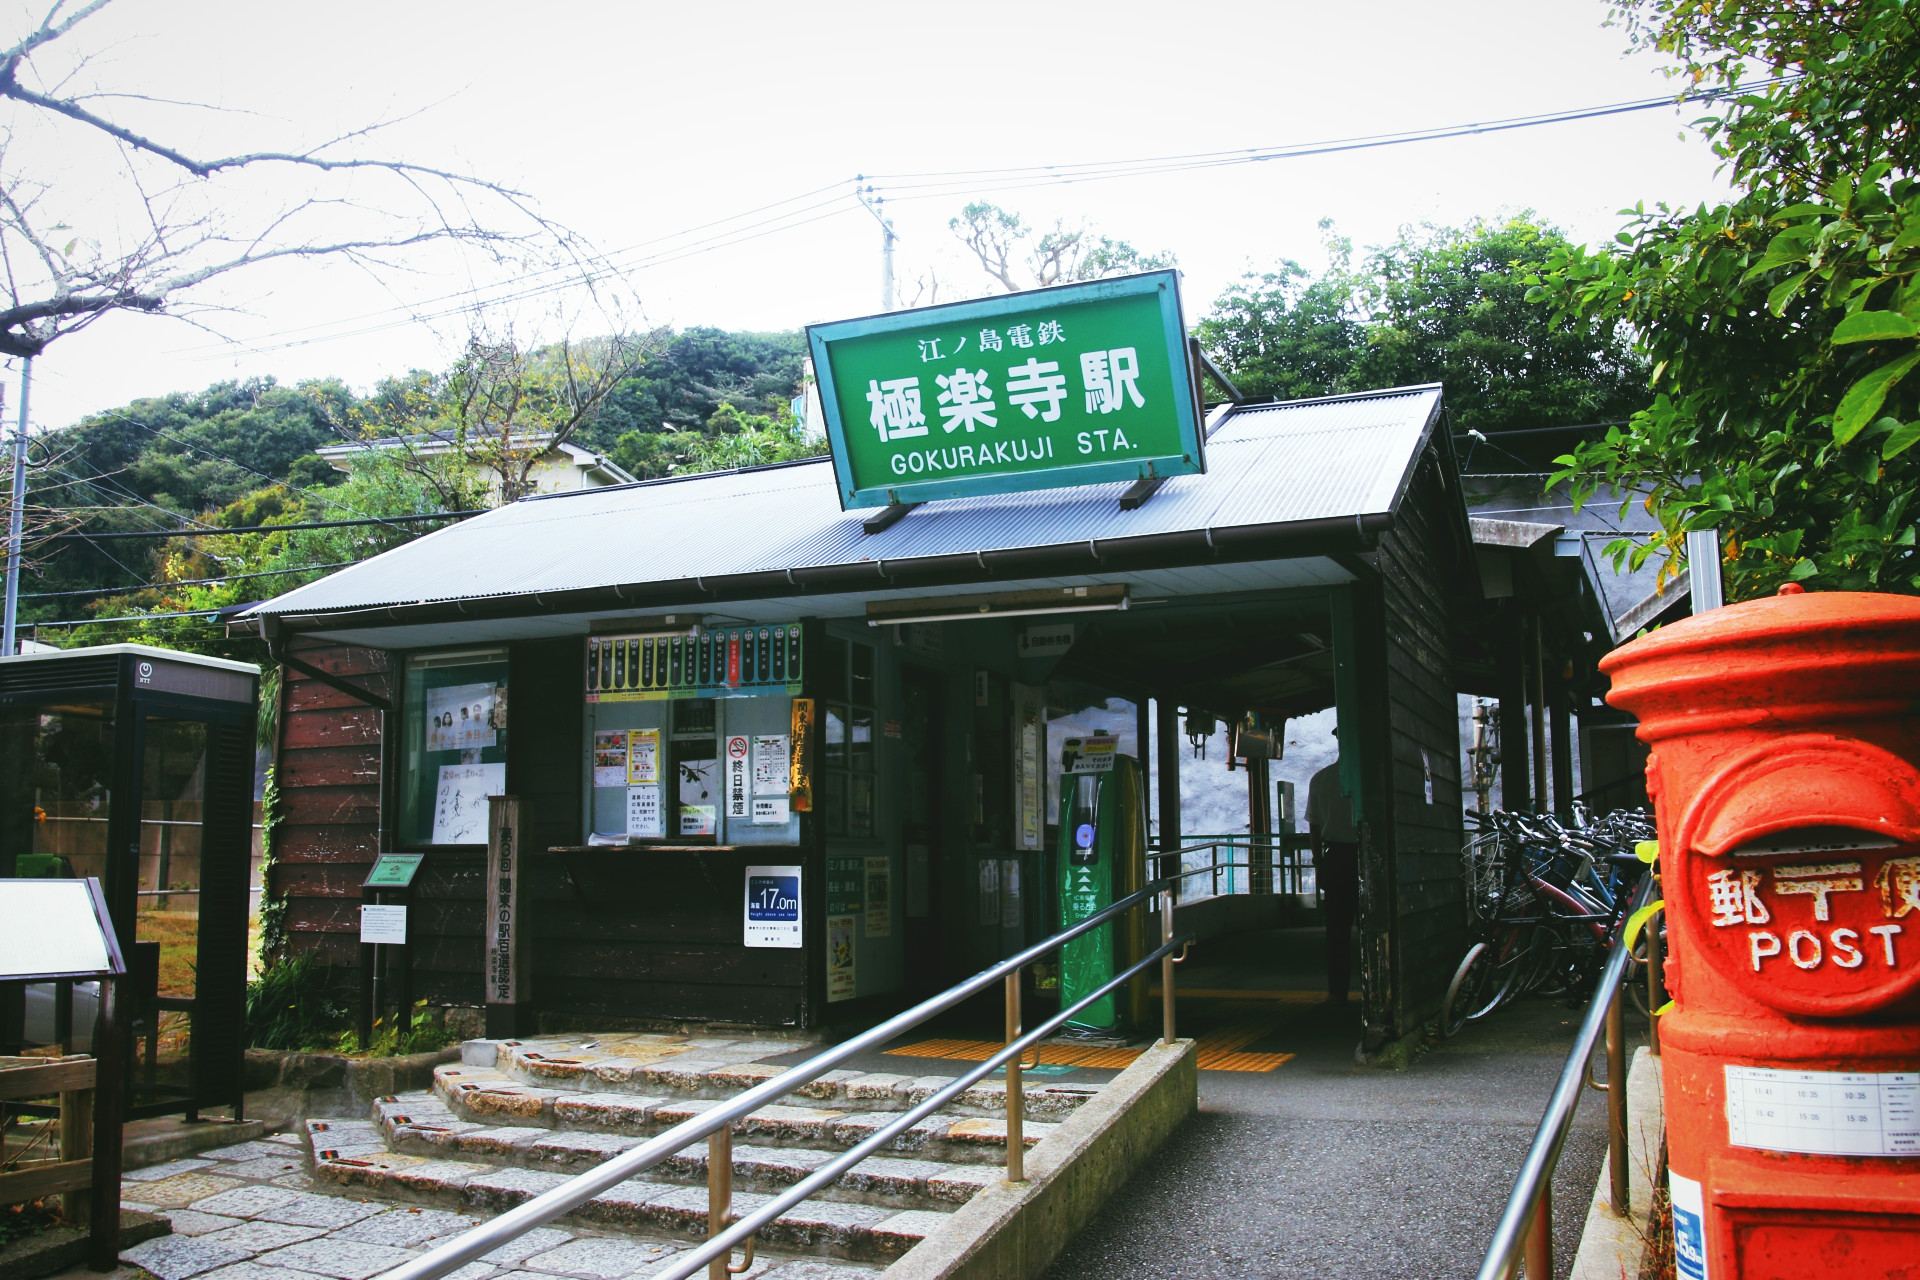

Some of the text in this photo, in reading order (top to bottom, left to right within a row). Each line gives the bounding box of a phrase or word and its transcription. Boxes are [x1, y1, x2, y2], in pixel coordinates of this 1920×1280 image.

[918, 319, 1066, 363] 江ノ島電鉄
[866, 346, 1145, 442] 極楽寺駅
[891, 427, 1138, 475] GOKURAKUJI STA.
[139, 676, 151, 684] NTT
[732, 760, 744, 815] 終日禁煙
[760, 888, 797, 910] 17.0m
[1748, 924, 1902, 972] POST
[1754, 1087, 1867, 1100] 11:41 10:35 10:35
[1755, 1109, 1868, 1123] 15:42 15:05 15:05
